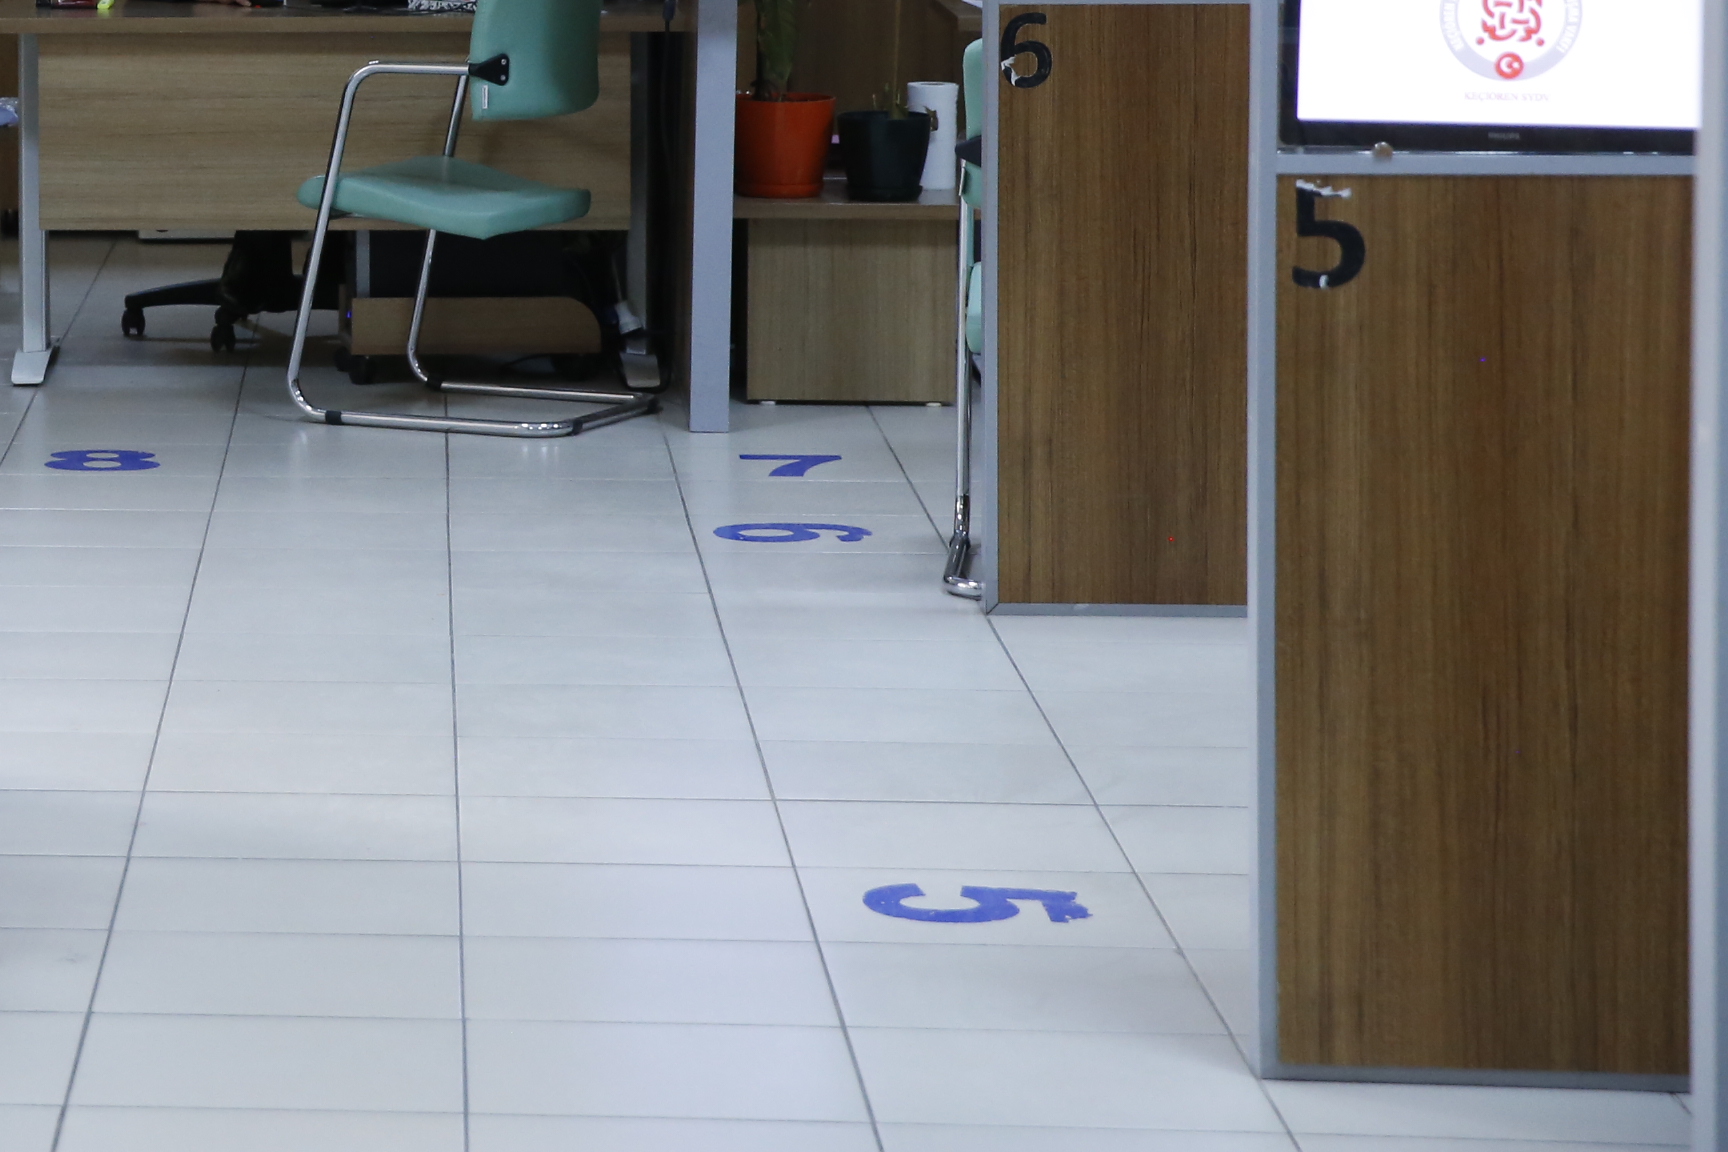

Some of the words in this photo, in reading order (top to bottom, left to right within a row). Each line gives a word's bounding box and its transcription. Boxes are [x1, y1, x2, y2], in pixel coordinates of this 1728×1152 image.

[1000, 12, 1053, 89] 6
[1291, 181, 1366, 290] 5
[45, 449, 161, 472] 8
[738, 454, 842, 477] 7
[863, 884, 1092, 923] 5
